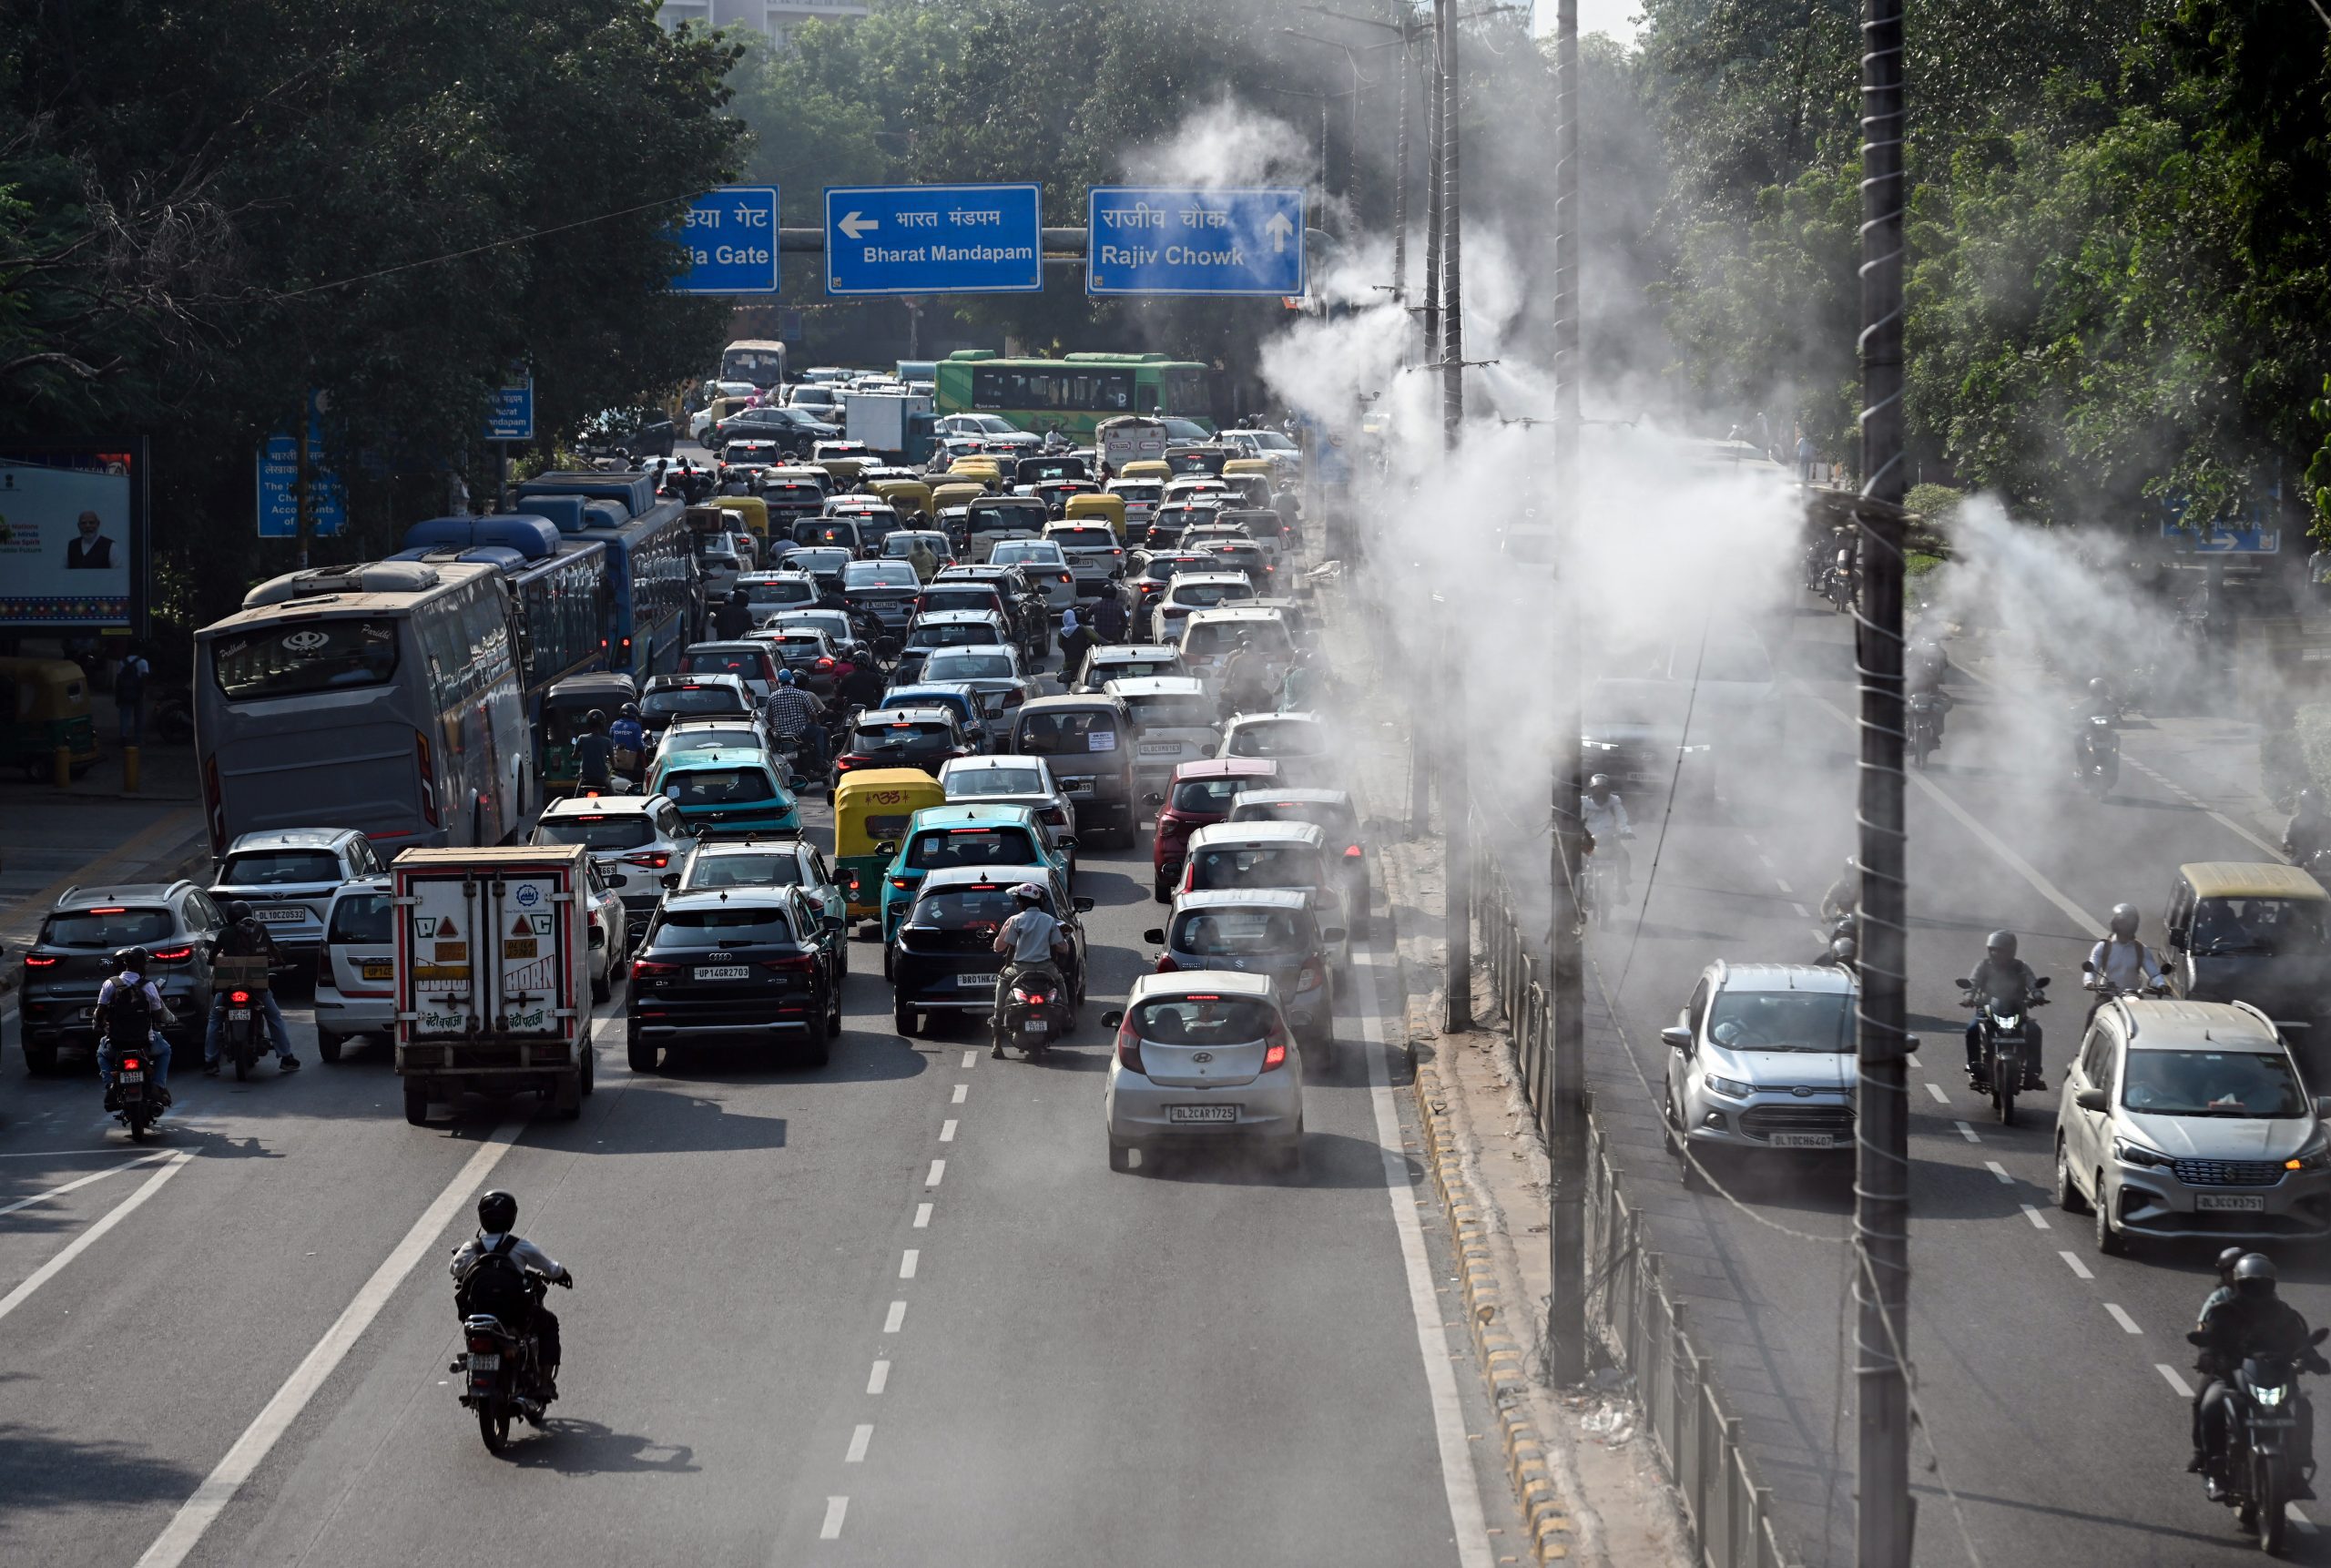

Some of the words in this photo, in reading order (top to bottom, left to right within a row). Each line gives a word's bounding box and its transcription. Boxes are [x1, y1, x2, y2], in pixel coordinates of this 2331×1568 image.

[733, 201, 769, 229] गेट
[896, 211, 938, 228] भारत
[948, 207, 1001, 226] मंडपम
[1100, 201, 1166, 229] राजीव
[1178, 202, 1227, 229] चौक
[716, 245, 769, 265] Gate
[863, 246, 926, 263] Bharat
[931, 244, 1033, 263] Mandapam
[1101, 245, 1158, 269] Rajiv
[1166, 245, 1245, 266] Chowk
[488, 418, 526, 427] andapam
[264, 482, 283, 491] The
[284, 516, 295, 525] of
[260, 910, 304, 920] DL10CZ0532
[504, 954, 555, 992] HORN
[699, 968, 748, 978] UP14GR2703
[962, 974, 999, 984] BR01HK4
[1177, 1108, 1233, 1118] DL2CAR1725
[1775, 1135, 1833, 1146] DL10CH6407
